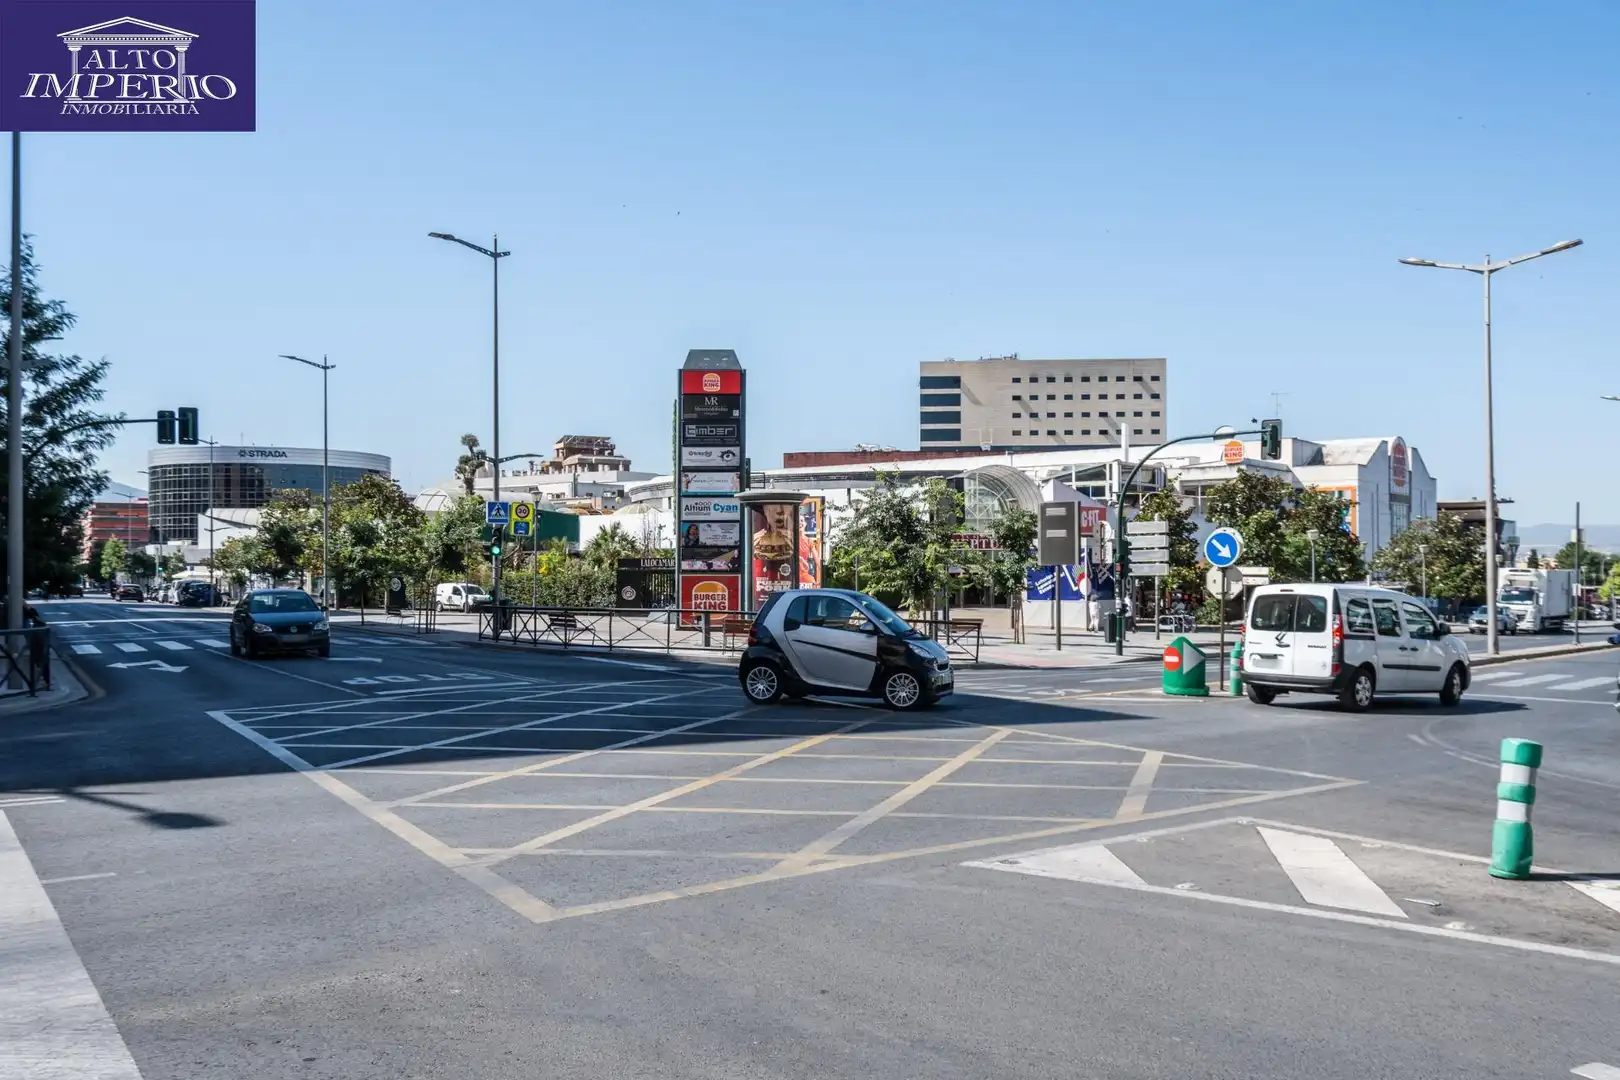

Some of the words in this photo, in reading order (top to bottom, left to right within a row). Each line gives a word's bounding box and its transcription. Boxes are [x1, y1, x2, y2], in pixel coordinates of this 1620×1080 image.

[704, 396, 718, 406] MR
[248, 450, 288, 458] STRADA
[713, 503, 738, 513] Cyan
[694, 593, 727, 601] BURGER
[694, 601, 727, 610] KING
